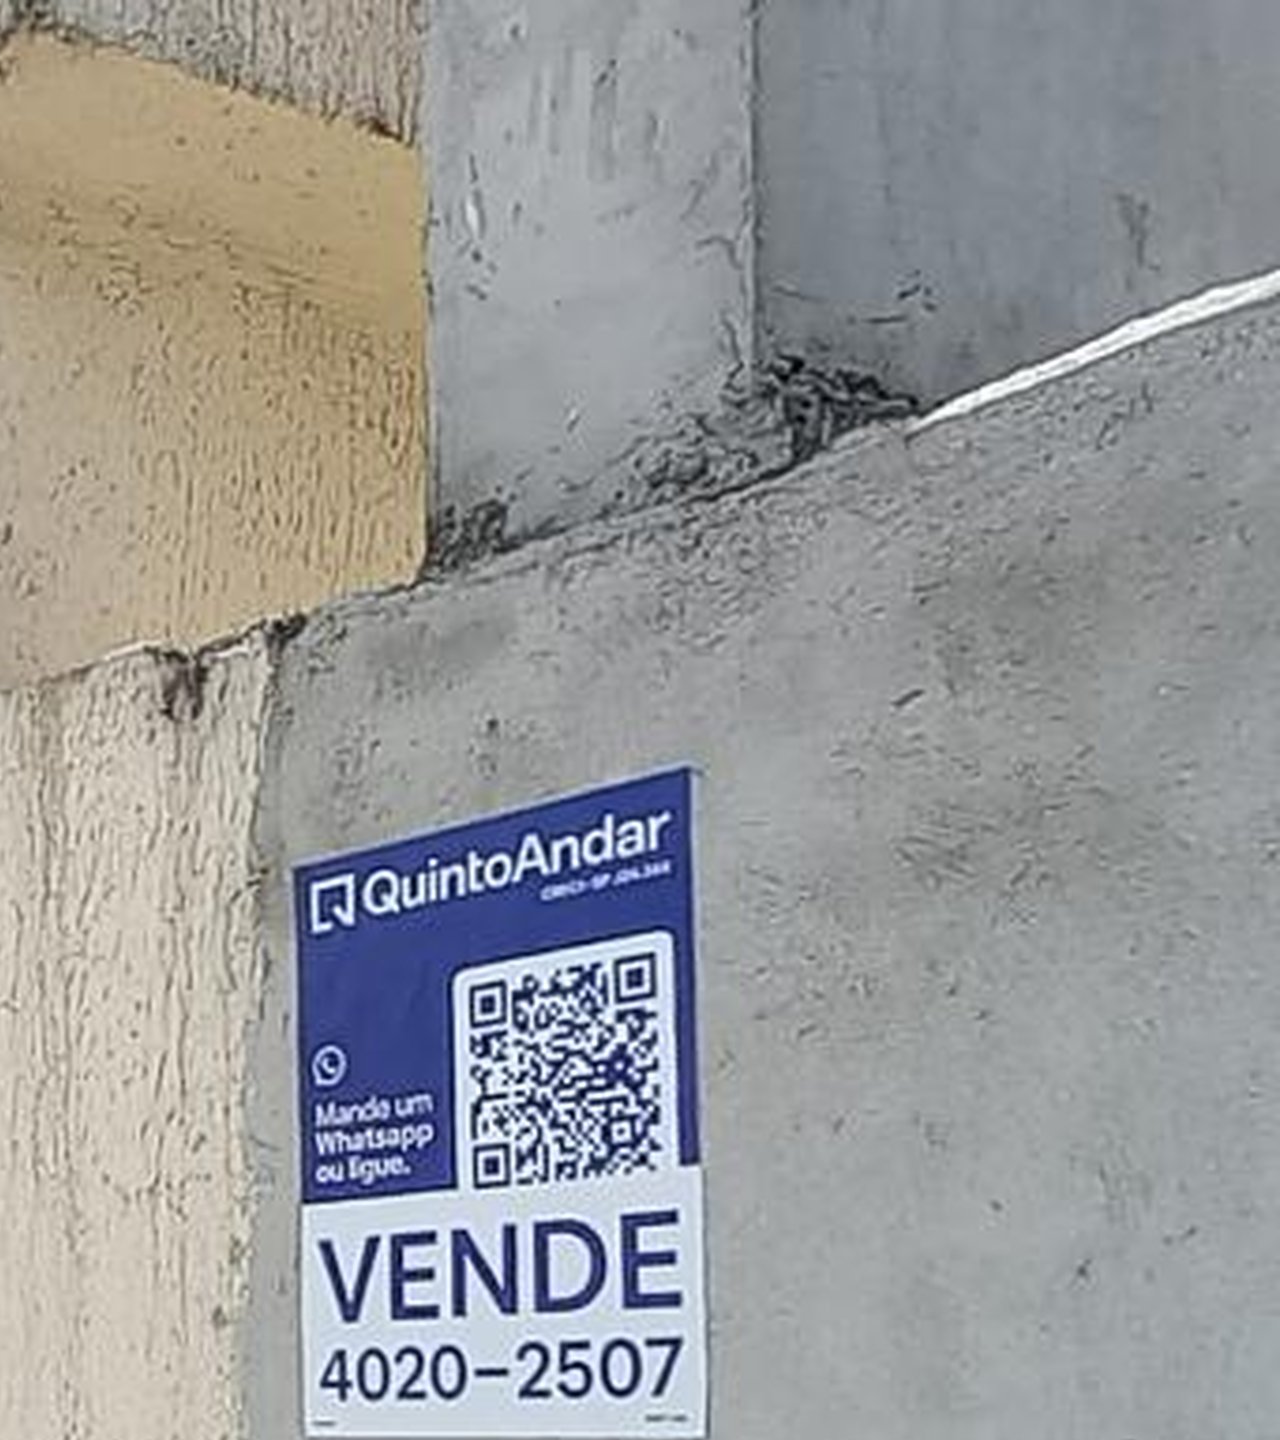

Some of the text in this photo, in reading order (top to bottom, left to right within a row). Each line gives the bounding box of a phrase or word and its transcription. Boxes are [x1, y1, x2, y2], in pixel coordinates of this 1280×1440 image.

[362, 811, 671, 916] QuintoAndar
[315, 1093, 433, 1127] Manda um
[315, 1155, 411, 1185] ou ligue.
[318, 1210, 684, 1323] VENDE
[319, 1338, 685, 1403] 4020-2507
